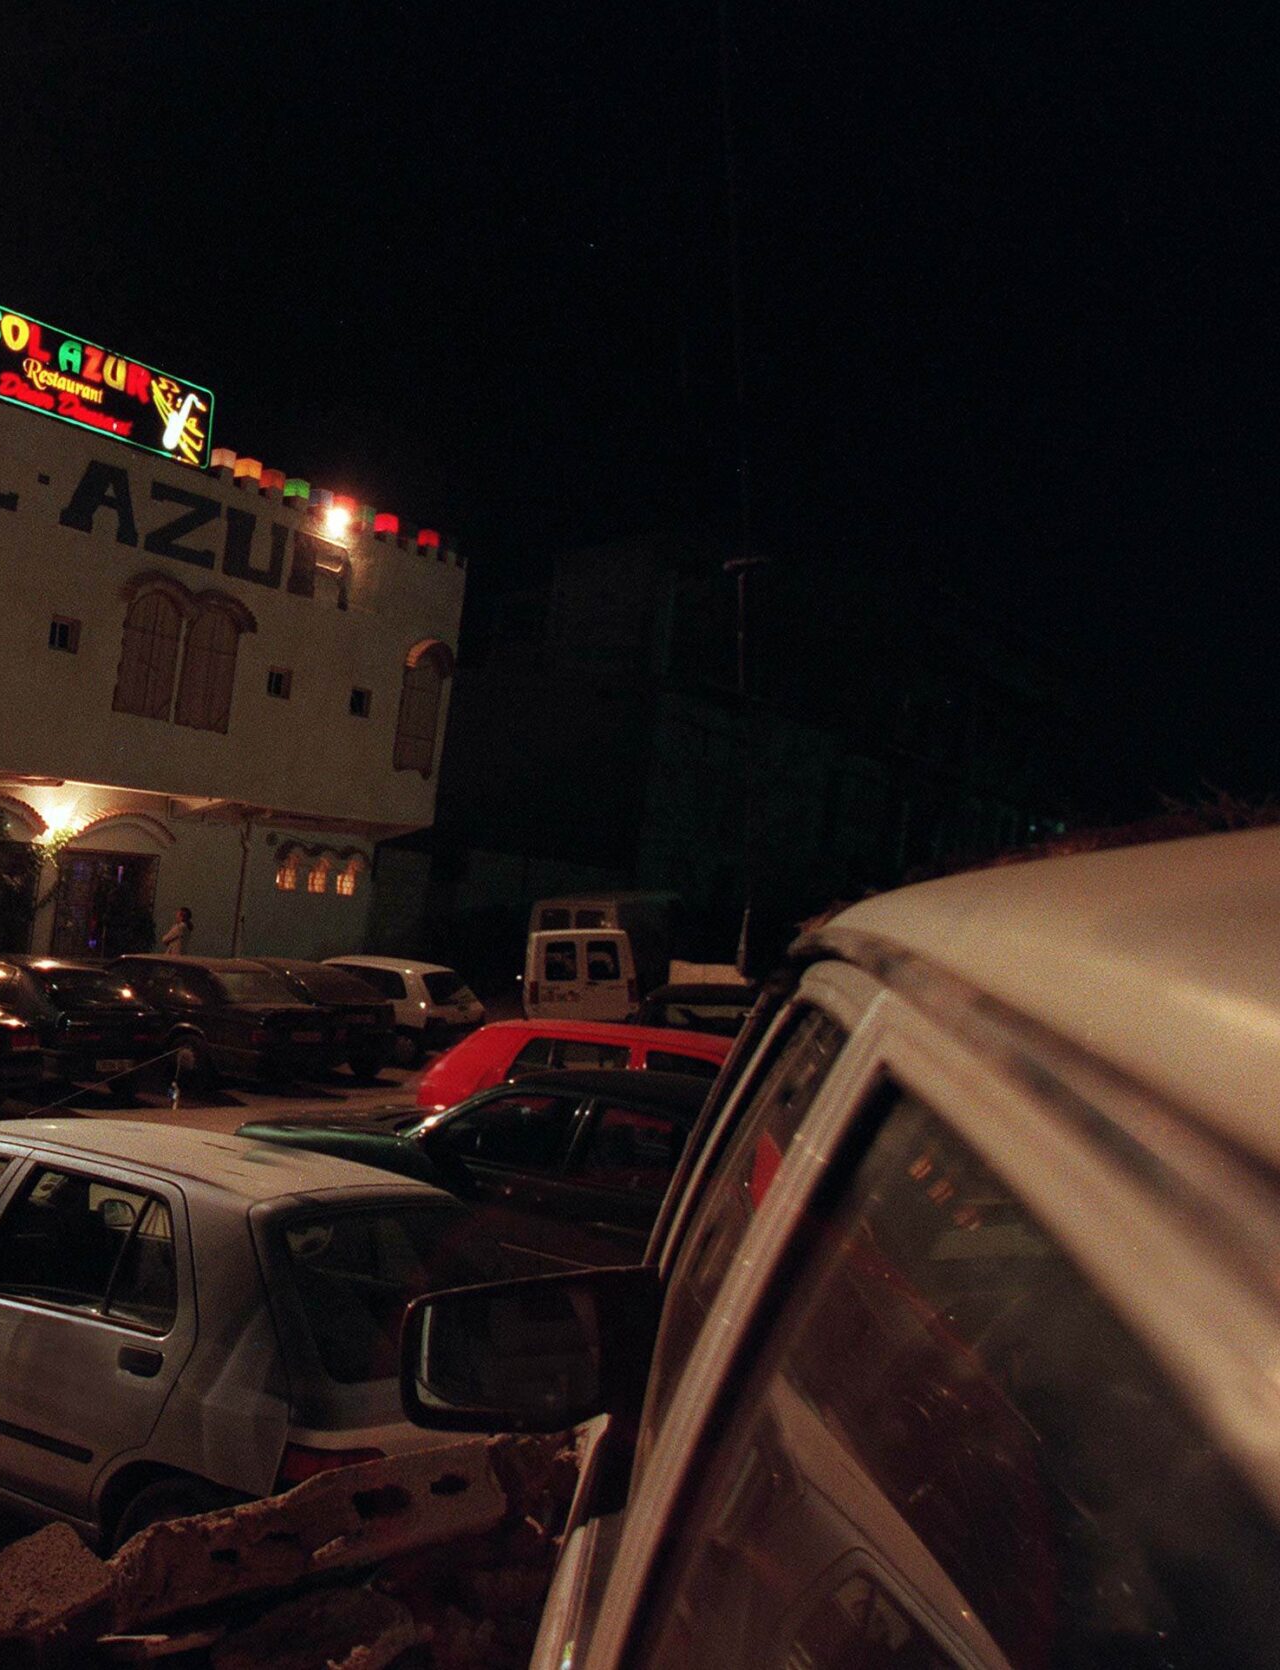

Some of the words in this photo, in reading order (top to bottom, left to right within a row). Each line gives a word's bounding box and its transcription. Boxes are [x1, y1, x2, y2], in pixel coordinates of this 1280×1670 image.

[22, 357, 104, 405] Restaurant
[58, 340, 153, 405] AZUR
[59, 460, 352, 611] AZUR
